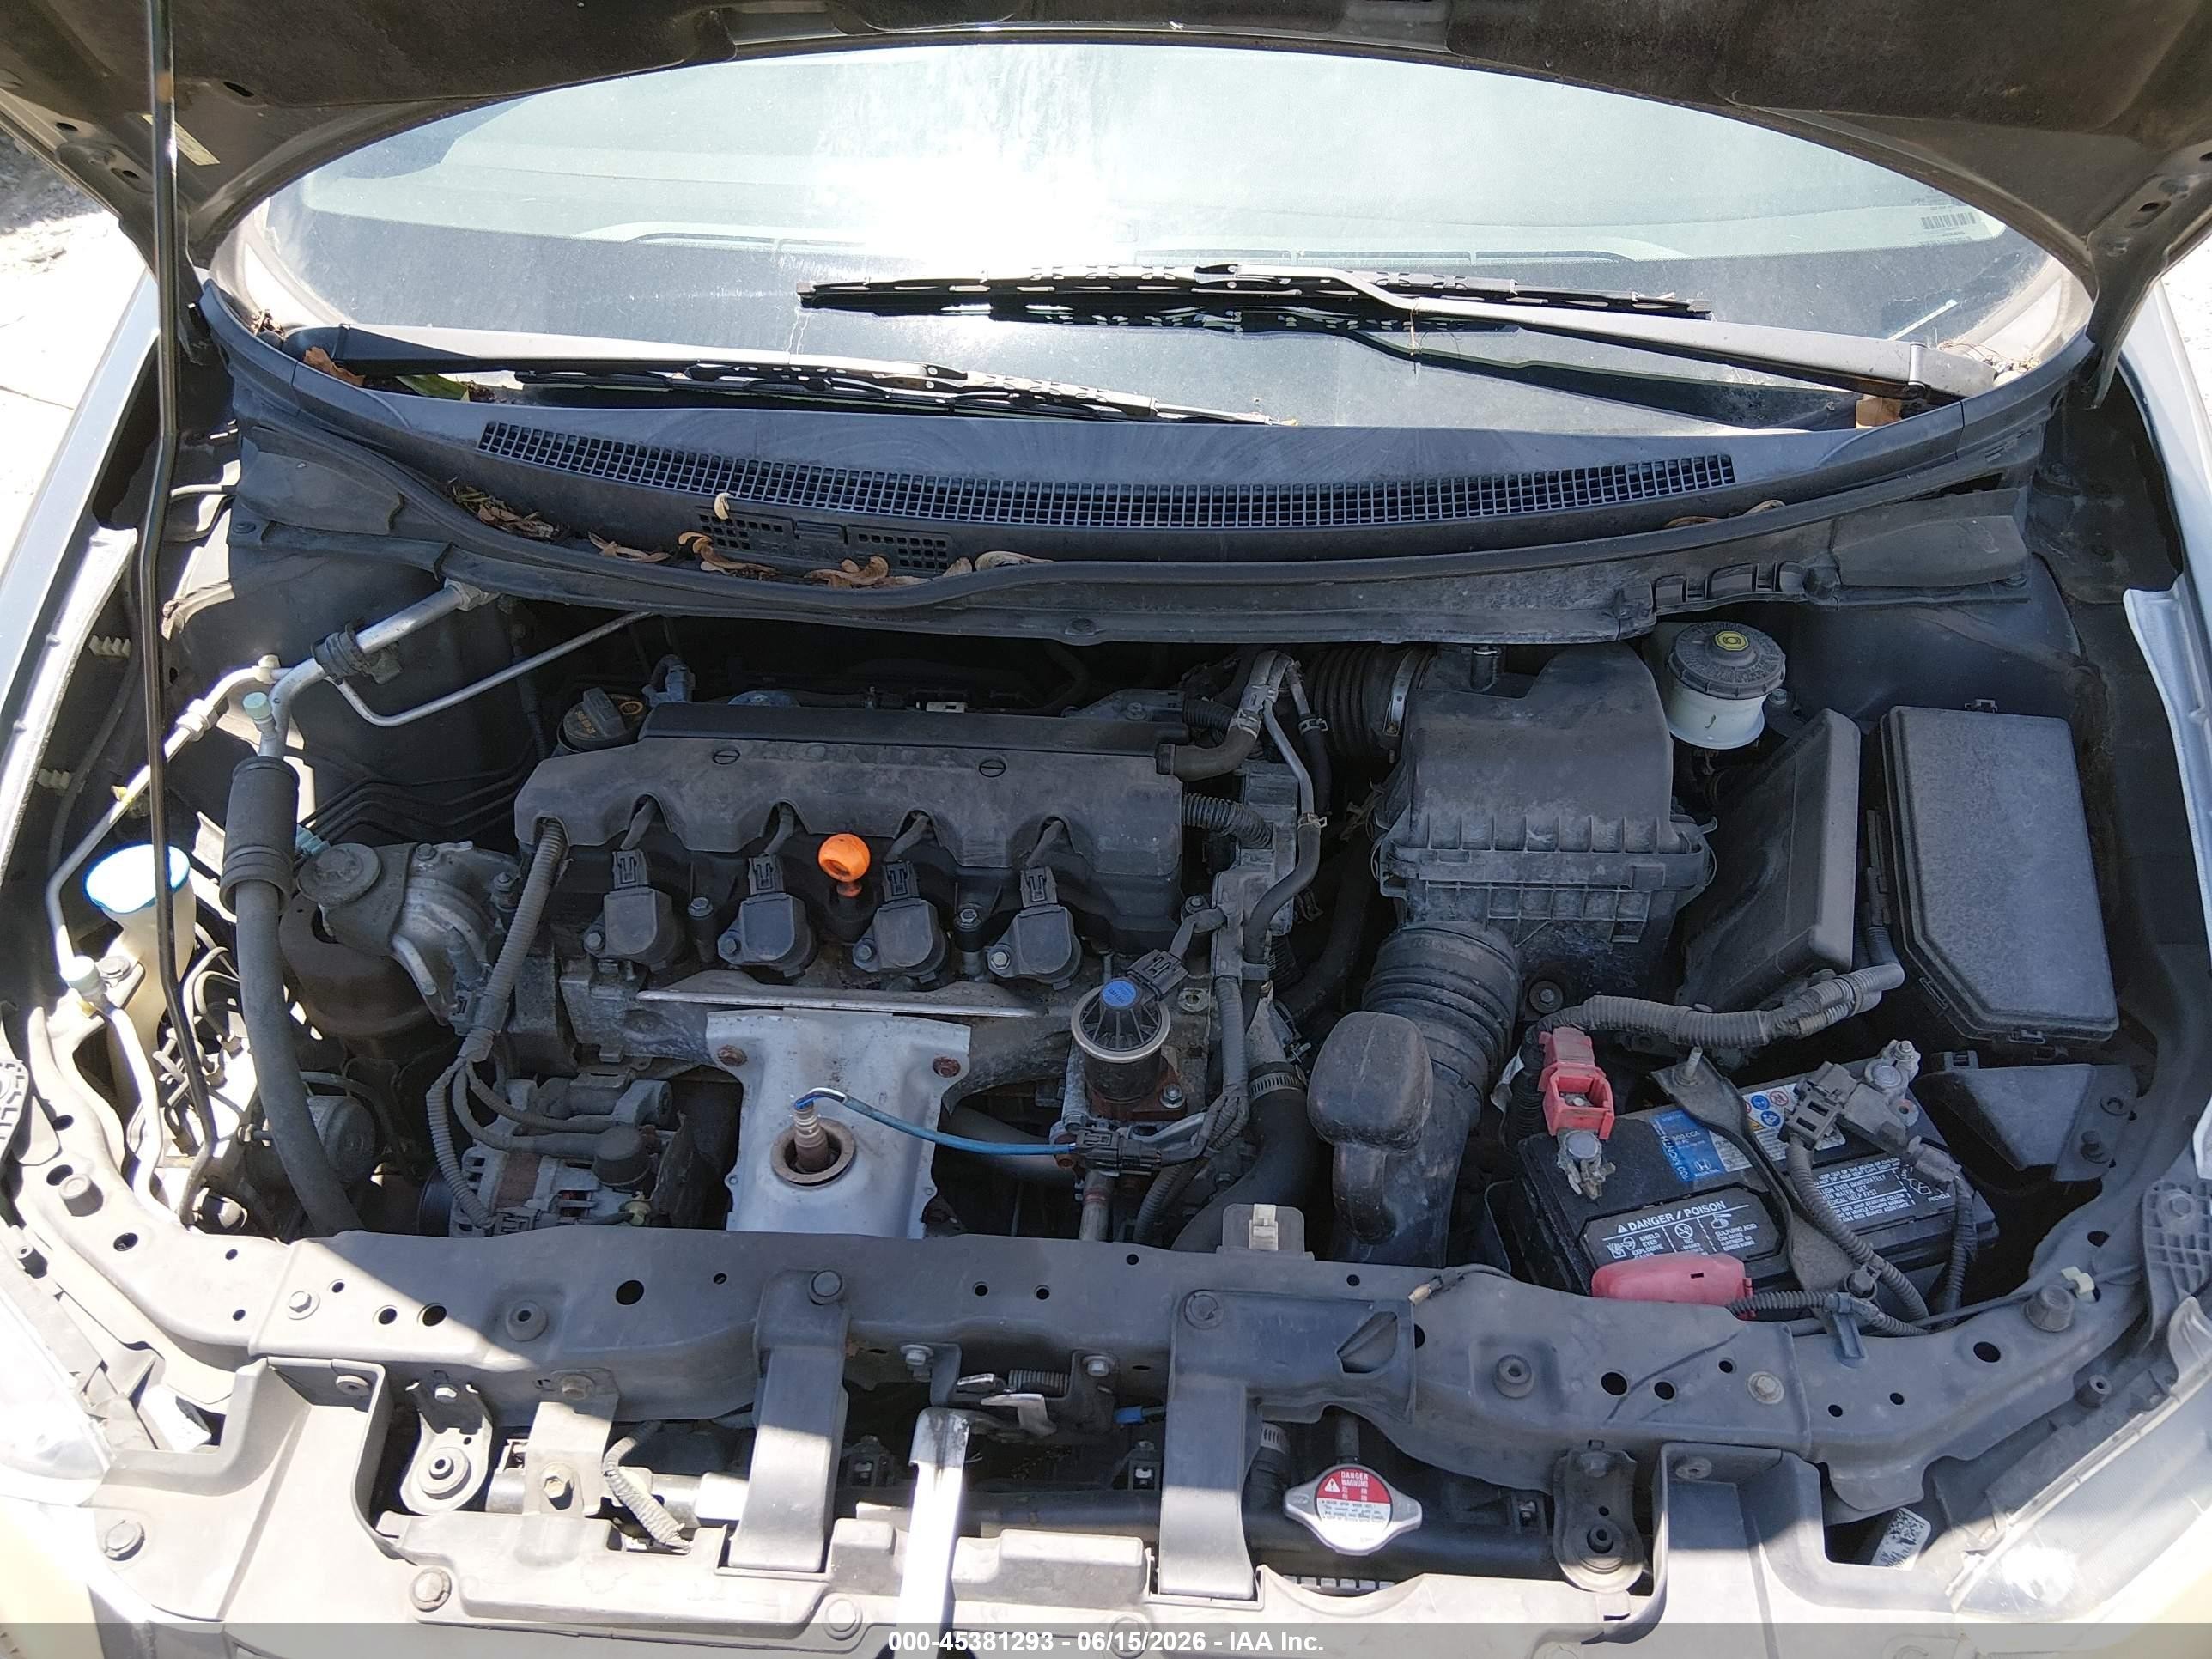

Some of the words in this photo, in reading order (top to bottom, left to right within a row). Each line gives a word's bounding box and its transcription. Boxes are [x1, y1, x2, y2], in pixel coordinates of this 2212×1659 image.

[1820, 1187, 1835, 1195] LUSH
[1834, 1183, 1850, 1192] EYES
[1850, 1175, 1886, 1188] IMMEDIATELY
[1827, 1197, 1848, 1206] EDICAL
[1627, 1213, 1674, 1231] DANGER
[1684, 1201, 1727, 1217] POISON
[1715, 1226, 1743, 1237] SULFURIC
[1632, 1244, 1664, 1255] EXPLOSIVE
